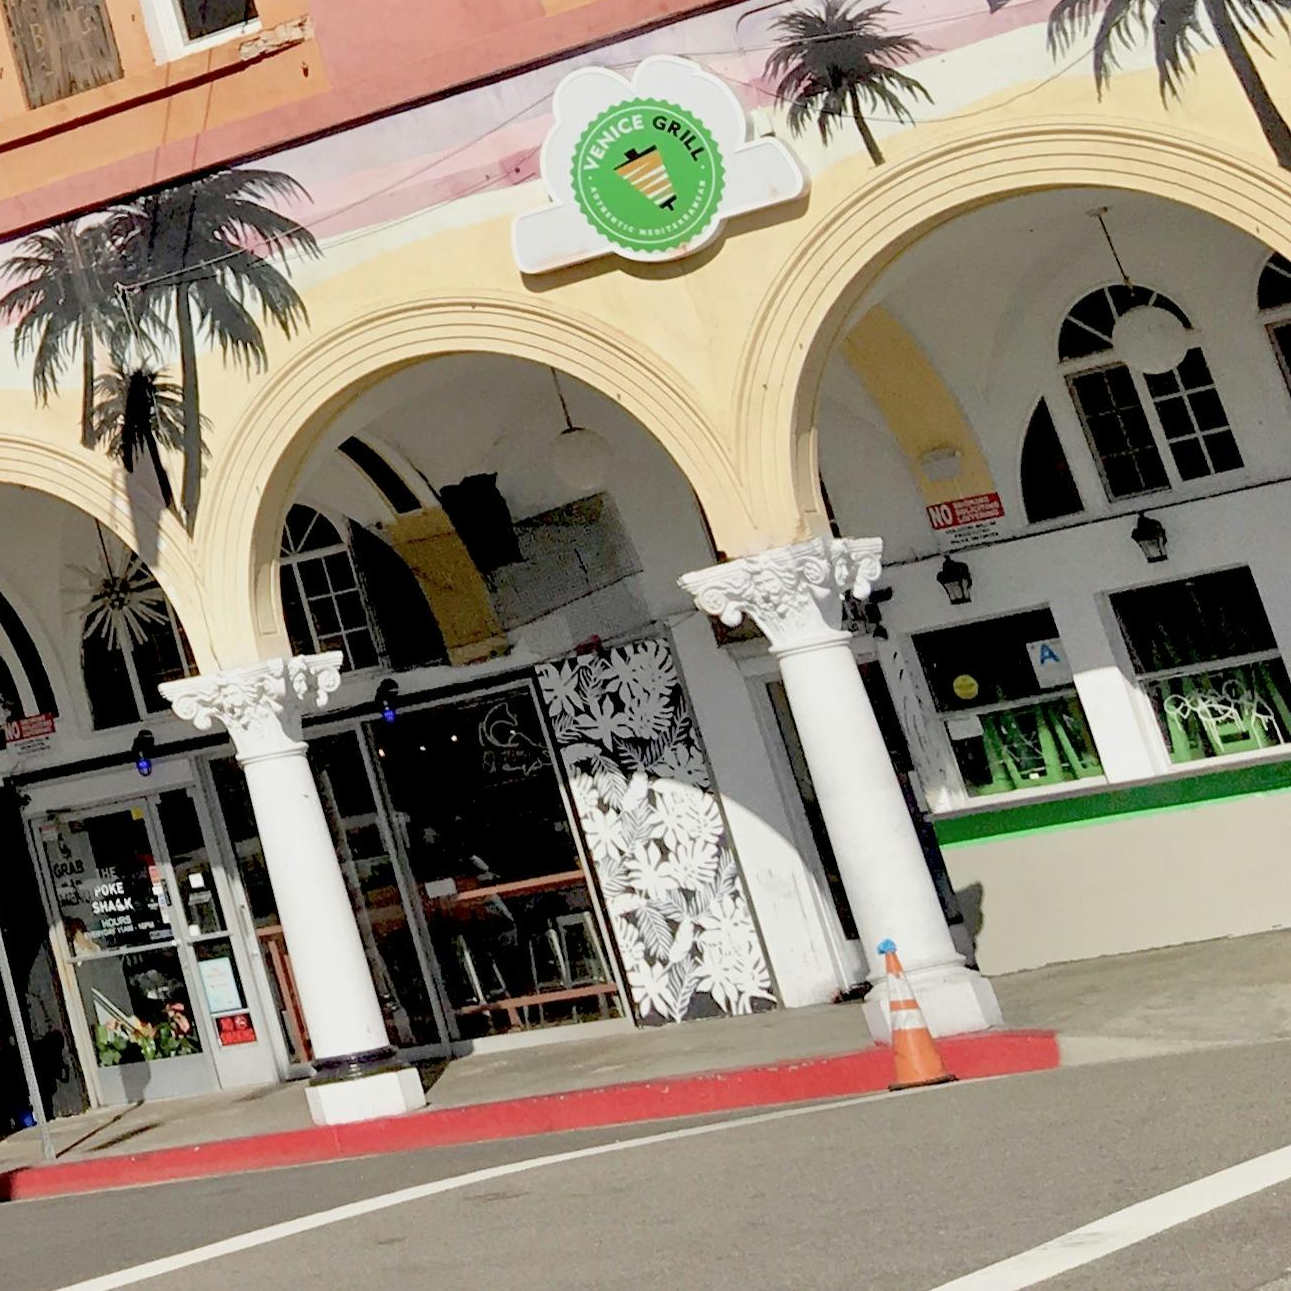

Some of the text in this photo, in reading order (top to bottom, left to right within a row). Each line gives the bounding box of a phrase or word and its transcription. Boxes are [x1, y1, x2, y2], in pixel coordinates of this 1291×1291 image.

[583, 114, 705, 170] VENICE GRILL
[928, 504, 953, 528] NO
[1040, 644, 1060, 664] A
[53, 860, 85, 878] GRAB
[94, 882, 125, 897] POKE
[101, 915, 132, 928] HOURS
